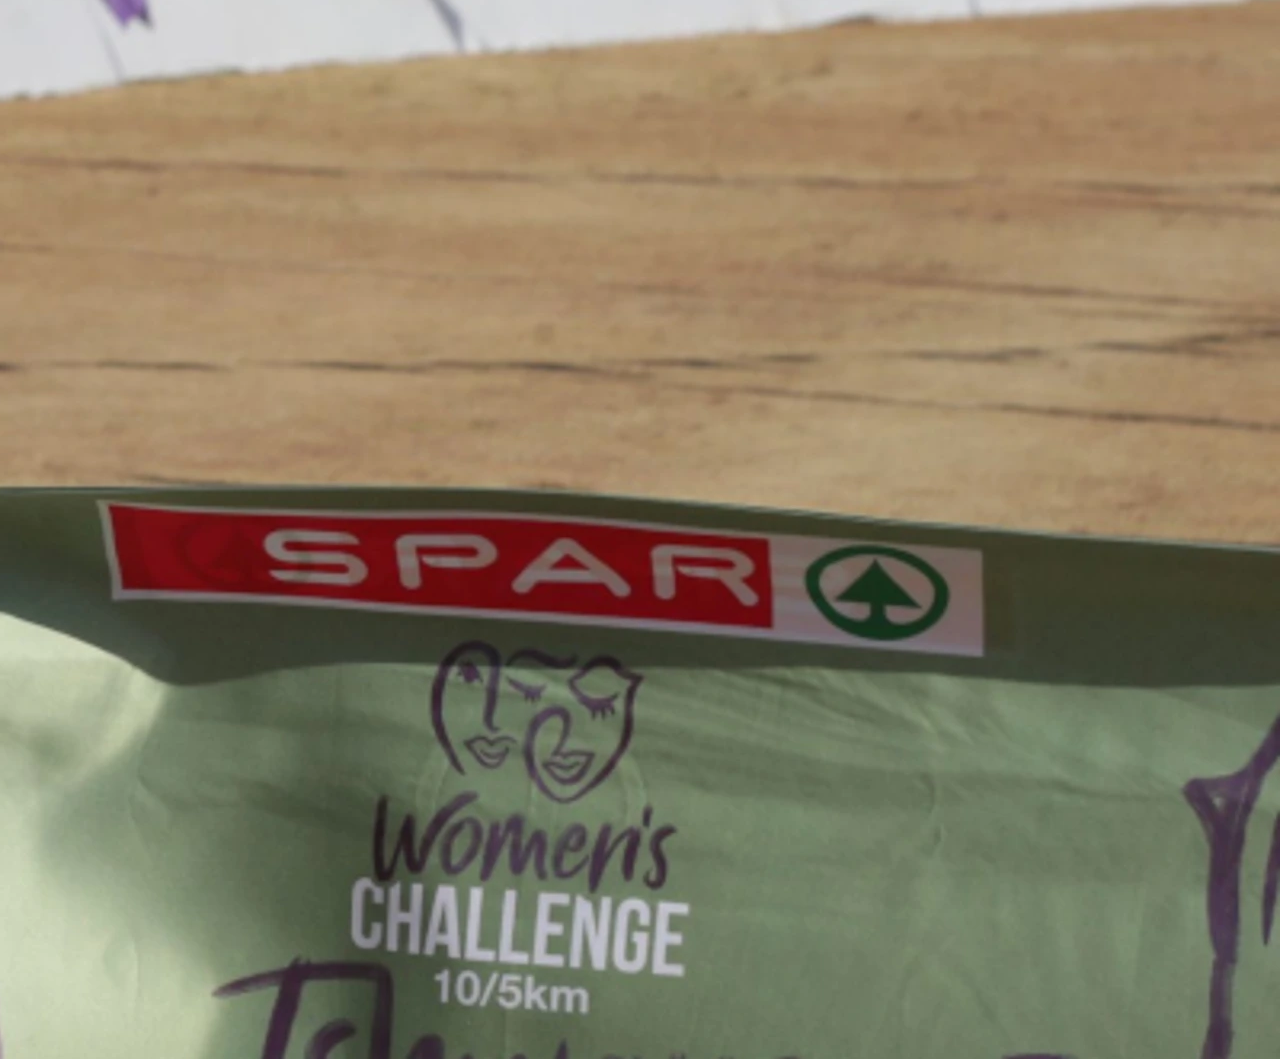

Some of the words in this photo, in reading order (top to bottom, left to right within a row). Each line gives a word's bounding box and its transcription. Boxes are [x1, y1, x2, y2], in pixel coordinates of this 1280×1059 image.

[261, 527, 761, 609] SPAR
[370, 789, 679, 890] Women's
[349, 876, 690, 977] CHALLENGE
[434, 970, 591, 1015] 10/5km
